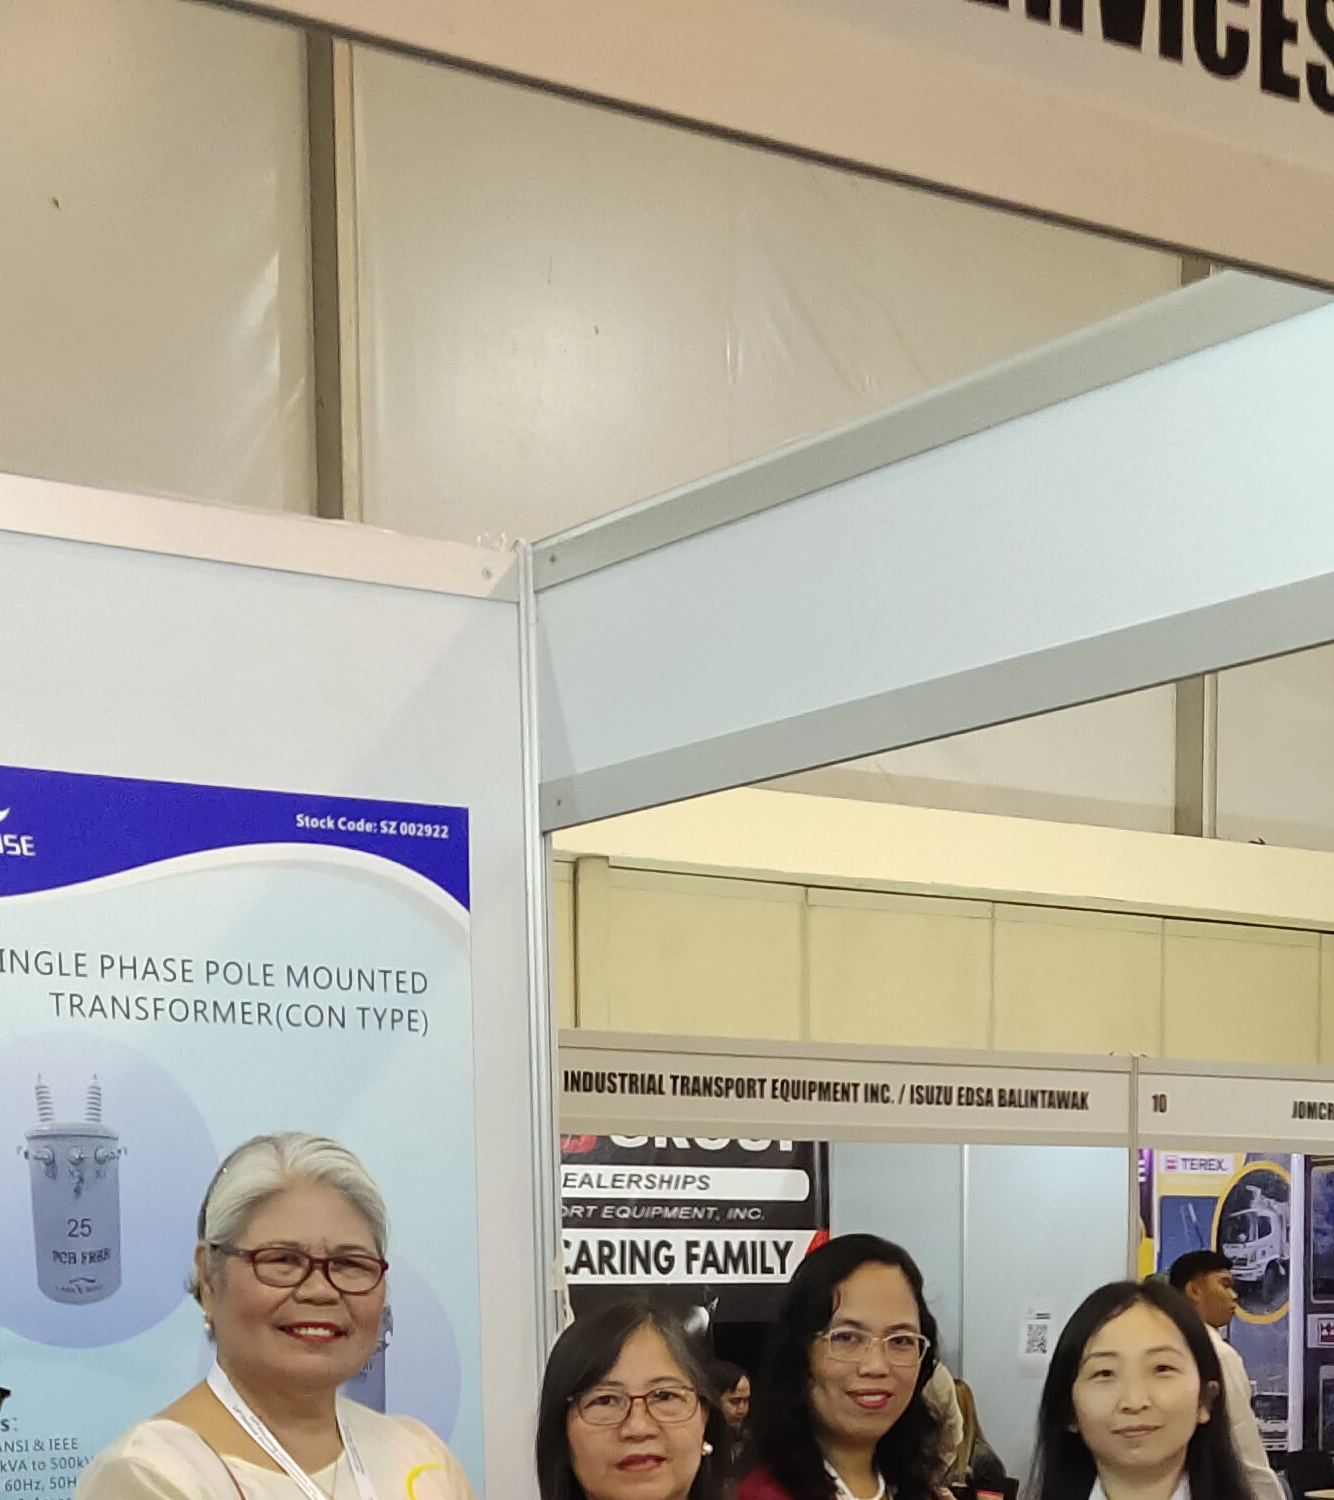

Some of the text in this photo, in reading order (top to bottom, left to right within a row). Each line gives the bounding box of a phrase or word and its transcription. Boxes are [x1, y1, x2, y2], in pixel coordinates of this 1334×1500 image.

[295, 813, 449, 839] Stock Code: SZ 002922
[99, 954, 195, 983] PHASE
[205, 960, 275, 988] POLE
[285, 964, 428, 995] MOUNTED
[48, 992, 429, 1037] TRANSFORMER(CON TYPE)
[563, 1070, 665, 1096] INDUSTRIAL
[670, 1074, 767, 1100] TRANSPORT
[771, 1078, 861, 1105] EQUIPMENT
[864, 1083, 896, 1104] INC.
[910, 1084, 954, 1106] ISUZU
[957, 1086, 995, 1108] EDSA
[997, 1088, 1090, 1111] BALINTAWAK
[1151, 1094, 1168, 1113] 10
[562, 1172, 711, 1191] EALERSHIPS
[562, 1204, 598, 1218] ORT
[726, 1207, 765, 1220] INC.
[67, 1218, 92, 1238] 25
[52, 1249, 76, 1264] PCB
[685, 1239, 794, 1275] FAMILY
[34, 1439, 45, 1451] &
[48, 1437, 79, 1451] IEEE
[32, 1458, 46, 1471] to
[51, 1455, 95, 1471] 500kV
[5, 1479, 45, 1493] 60Hz,
[49, 1476, 78, 1490] 50H
